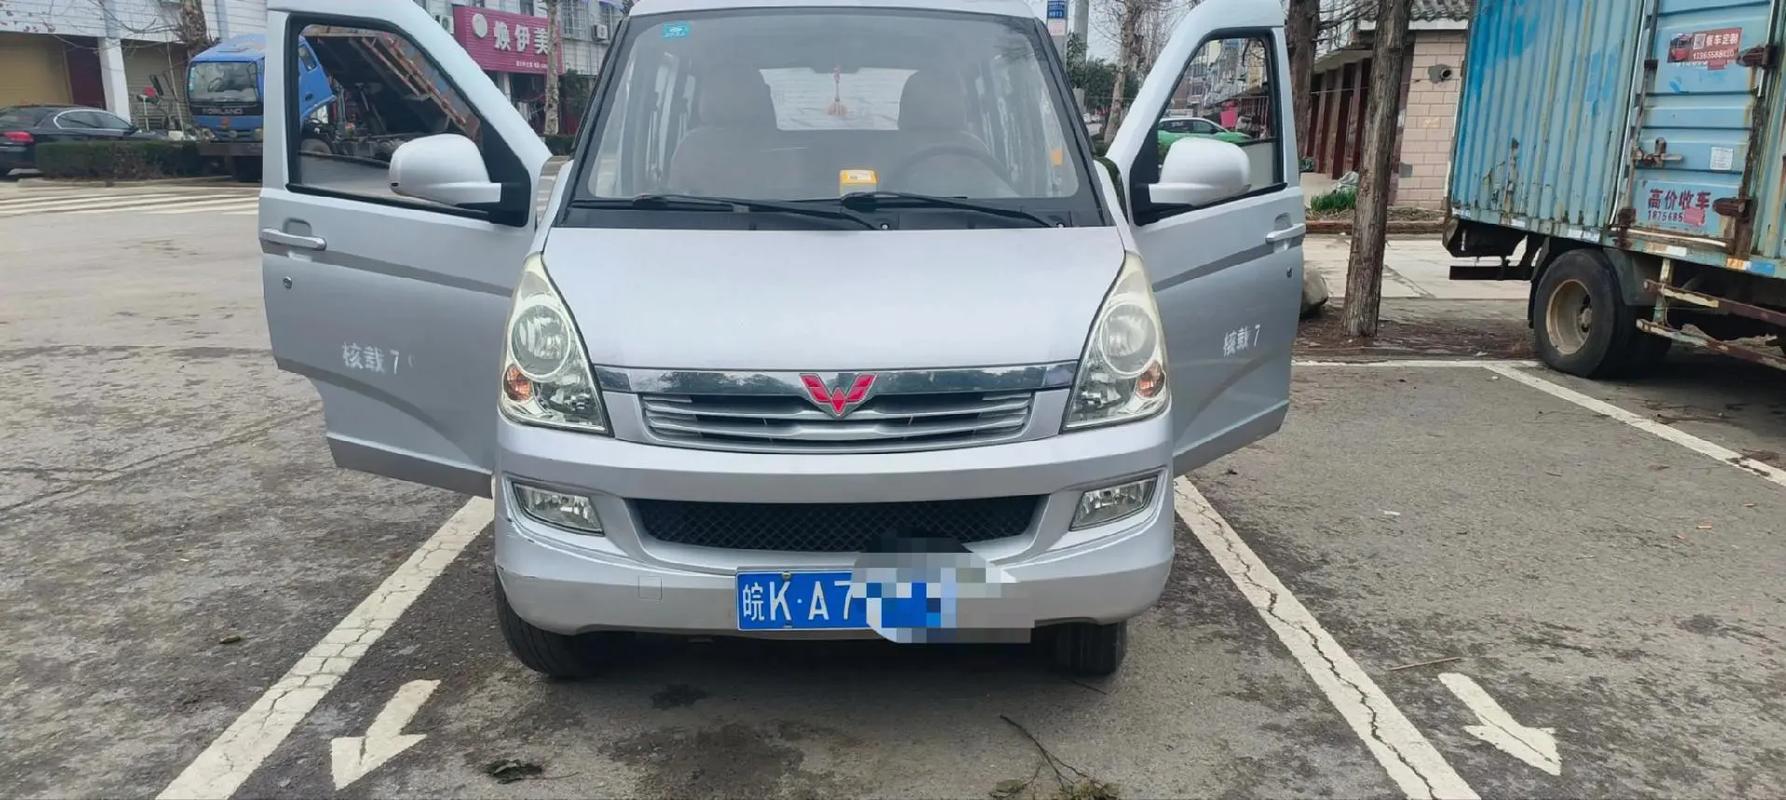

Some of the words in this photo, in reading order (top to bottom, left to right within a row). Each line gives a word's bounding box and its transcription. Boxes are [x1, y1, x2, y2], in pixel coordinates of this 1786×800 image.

[1648, 188, 1711, 210] 高价收车
[741, 580, 859, 623] 皖K·A7
